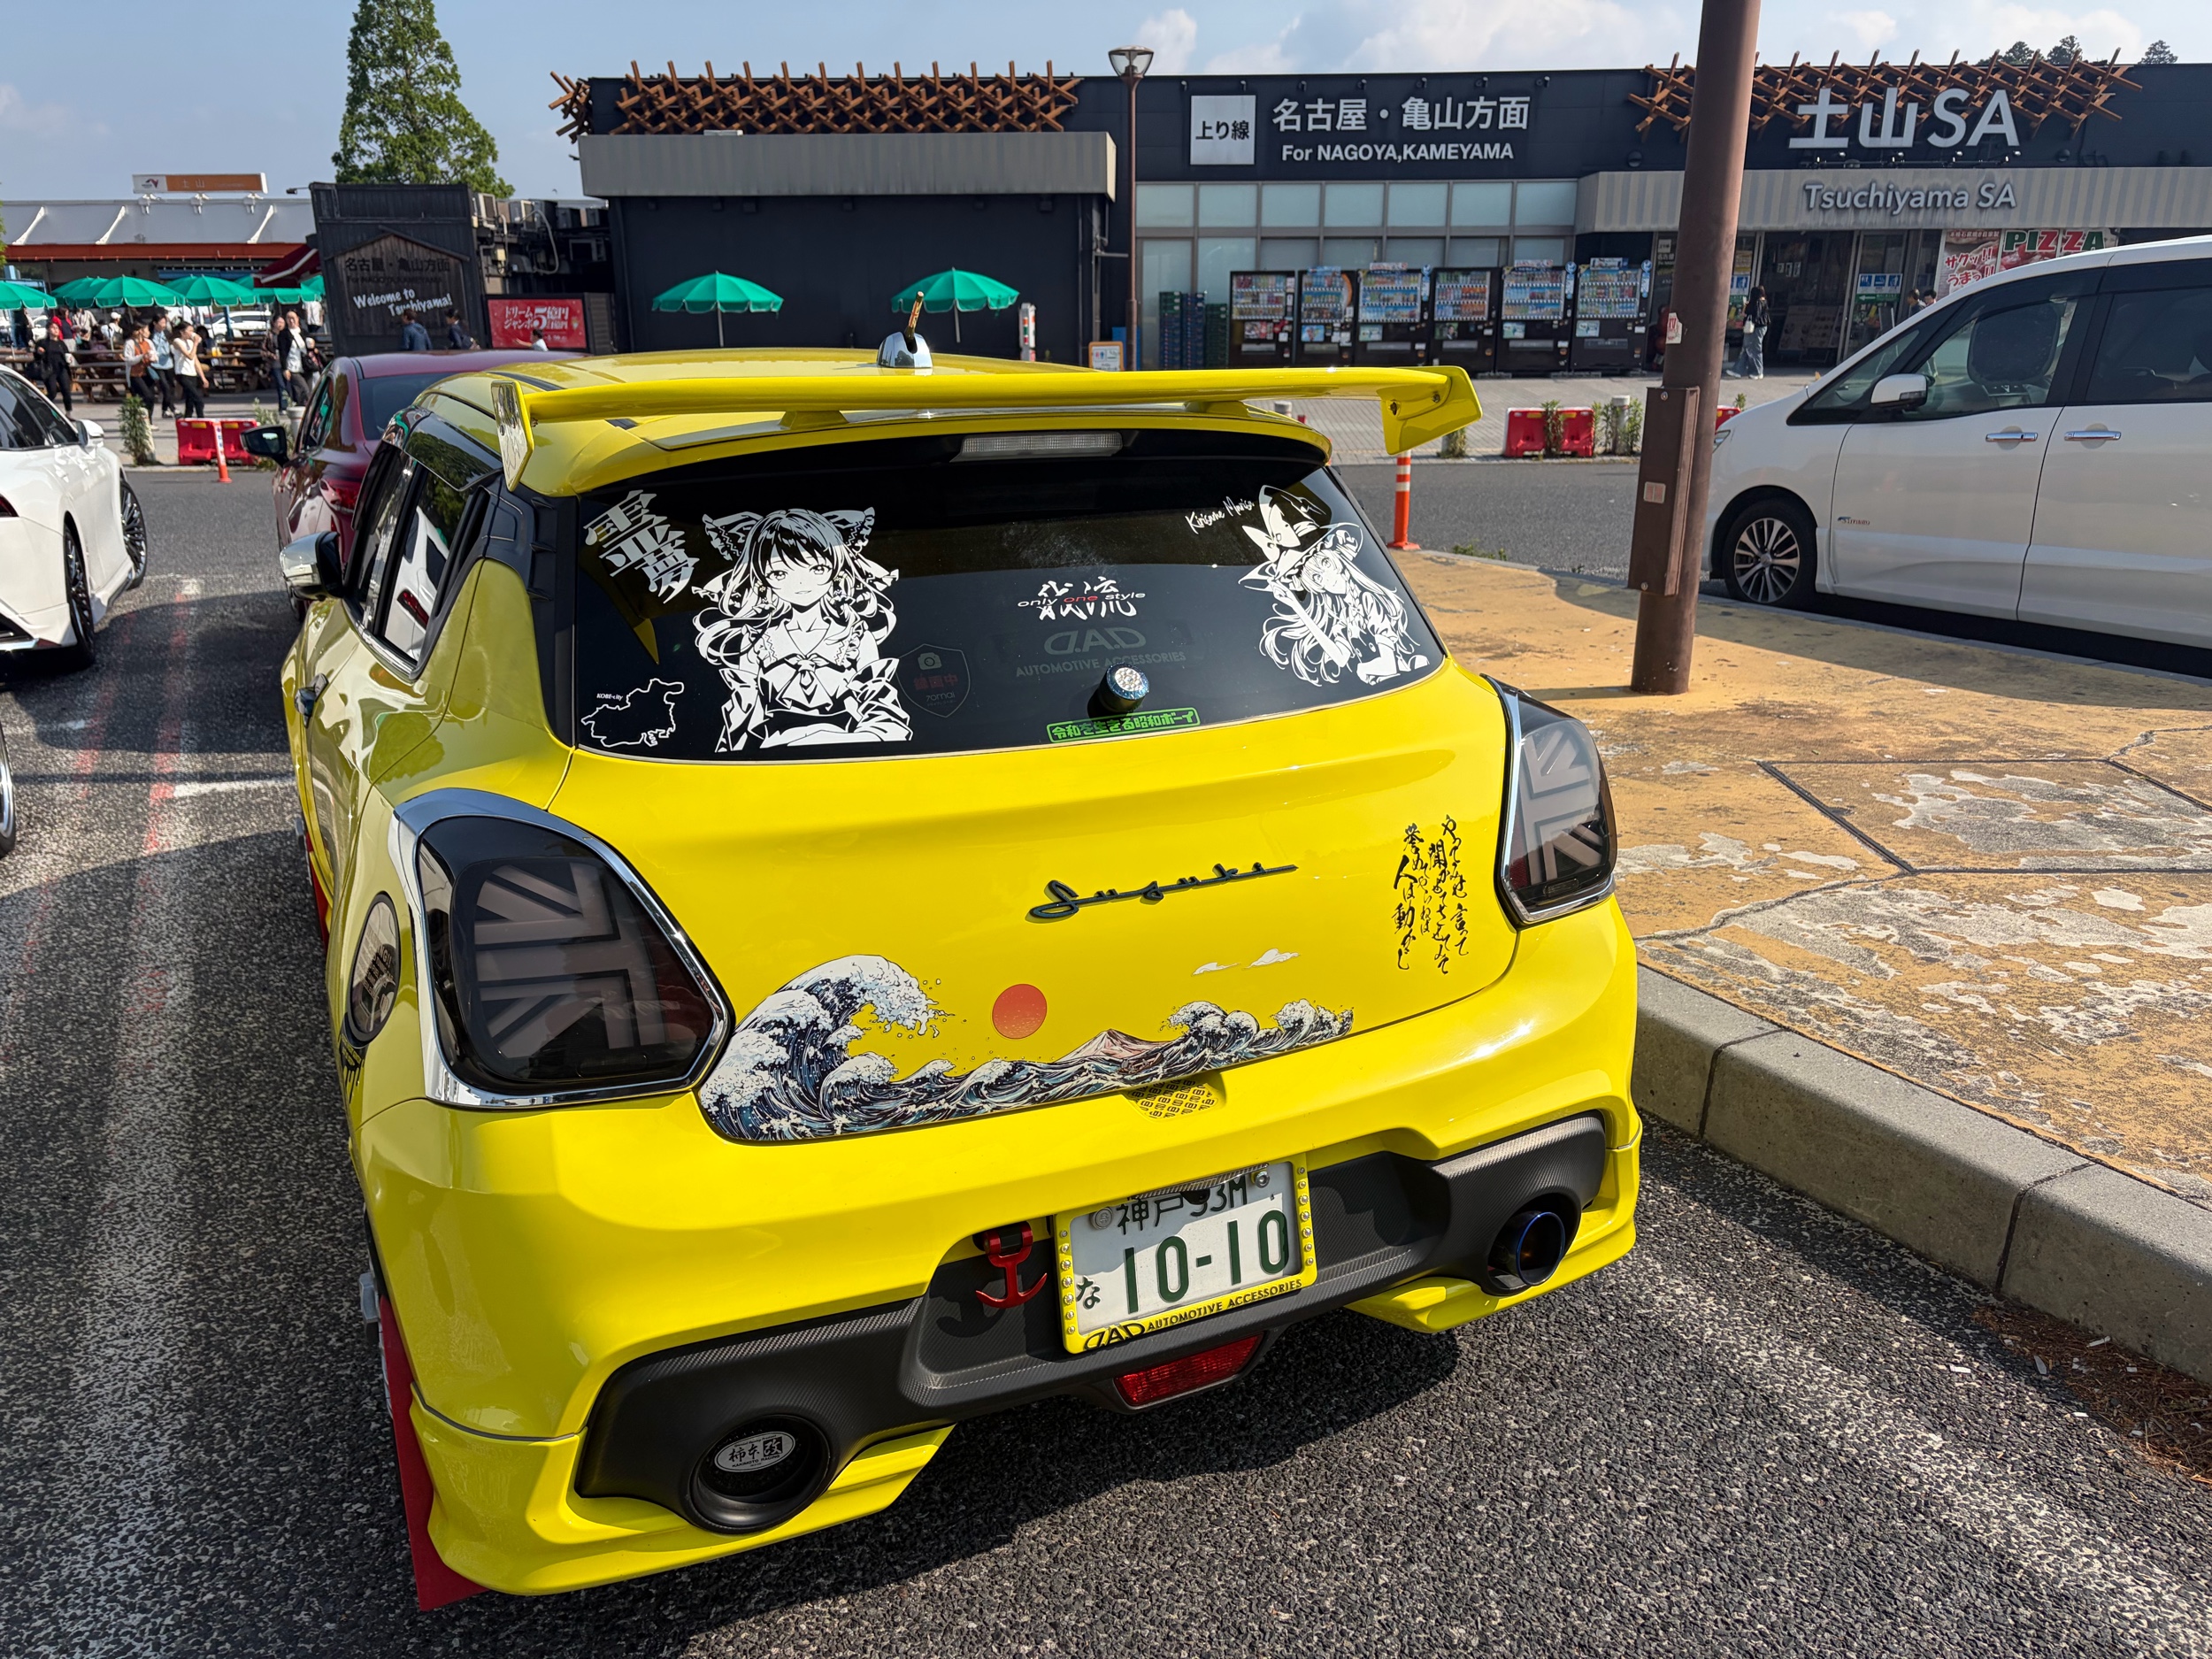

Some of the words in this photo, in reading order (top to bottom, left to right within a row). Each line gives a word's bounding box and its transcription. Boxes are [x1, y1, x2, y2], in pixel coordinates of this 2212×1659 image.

[1272, 96, 1531, 133] 名古屋・亀山方面
[1788, 88, 2020, 149] 土山SA
[1194, 119, 1250, 142] 上り線
[1281, 145, 1313, 162] For
[1317, 142, 1515, 164] NAGOYA,KAMEYAMA
[1804, 182, 1969, 215] Tsuchiyama
[1977, 182, 2017, 209] SA
[2004, 229, 2105, 252] PIZZA
[353, 291, 401, 309] Welcome
[403, 288, 416, 301] to
[1018, 596, 1059, 609] only
[1063, 593, 1099, 603] one
[1104, 591, 1147, 602] style
[1016, 657, 1100, 678] AUTOMOTIVE
[1103, 650, 1187, 671] ACCESSORIES
[926, 691, 956, 702] 70mai
[1052, 710, 1195, 740] 令和を生きる昭和ボーイ
[1116, 1194, 1184, 1235] 神戸
[1125, 1210, 1290, 1314] 10-10
[1076, 1275, 1101, 1310] な
[1148, 1302, 1223, 1331] AUTOMOTIVE
[1227, 1279, 1302, 1309] ACCESSORIES
[728, 1435, 783, 1463] 柿本改
